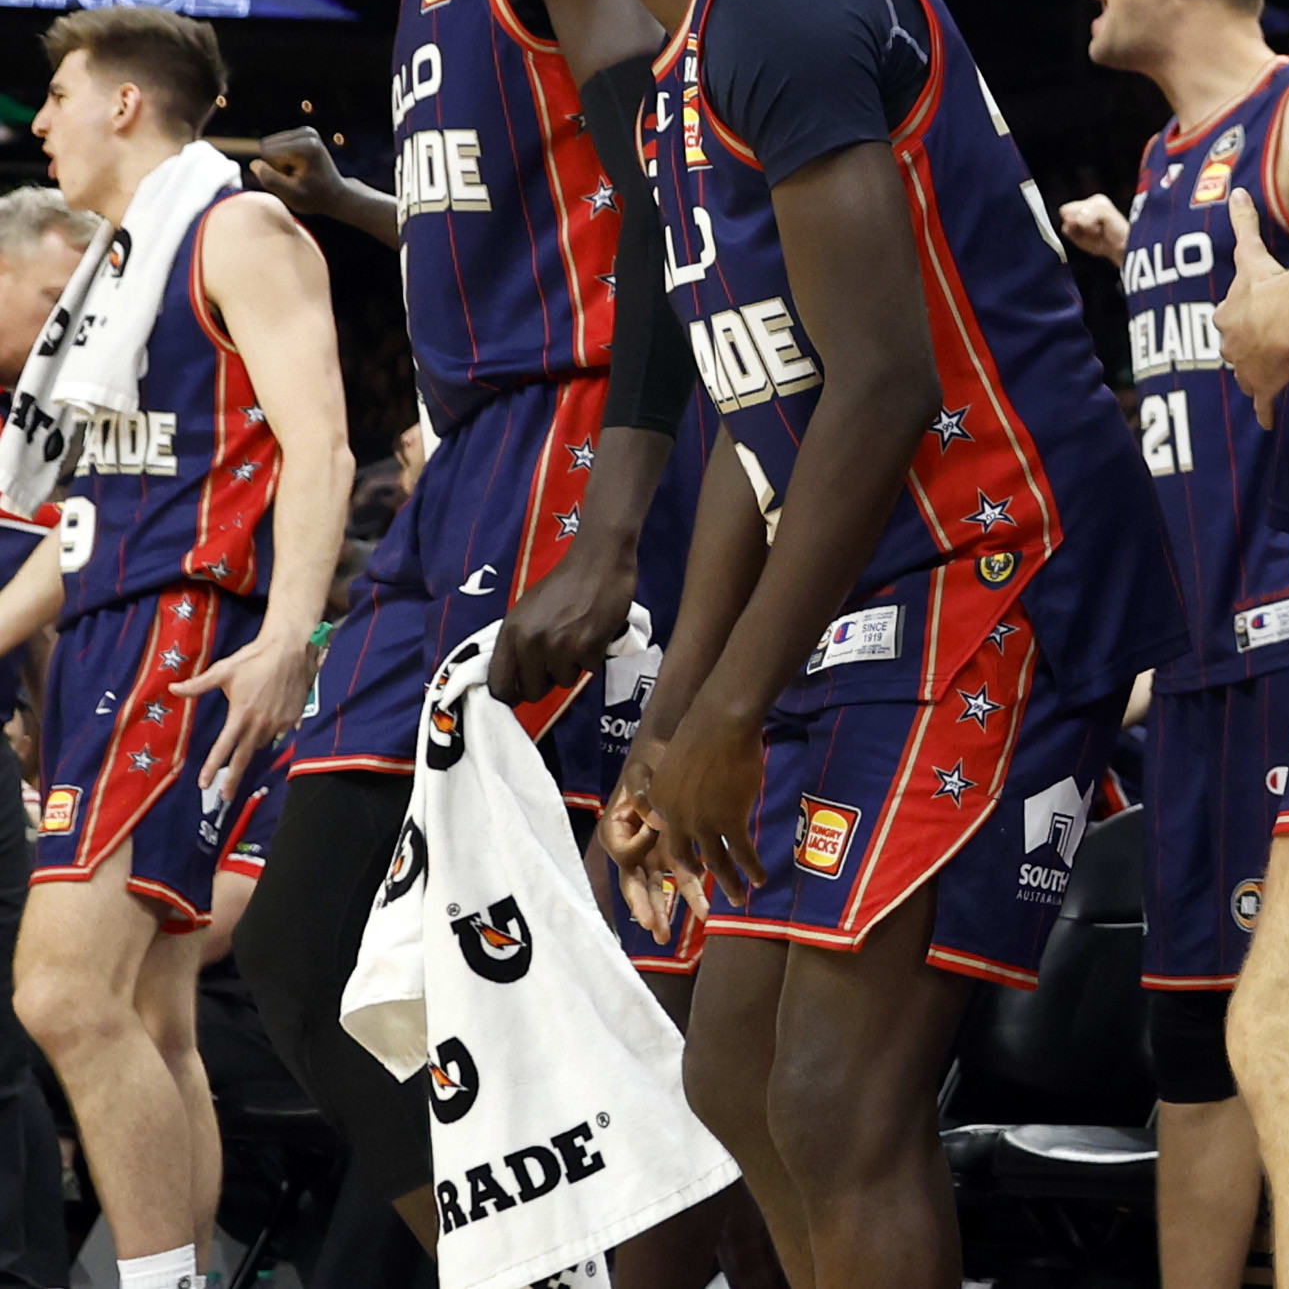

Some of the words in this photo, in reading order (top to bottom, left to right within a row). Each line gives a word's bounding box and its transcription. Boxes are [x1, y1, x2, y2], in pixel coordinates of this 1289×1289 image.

[1140, 390, 1194, 477] 21
[862, 621, 888, 633] SINCE
[1019, 862, 1069, 894] SOUTH
[437, 1120, 606, 1236] RADE
